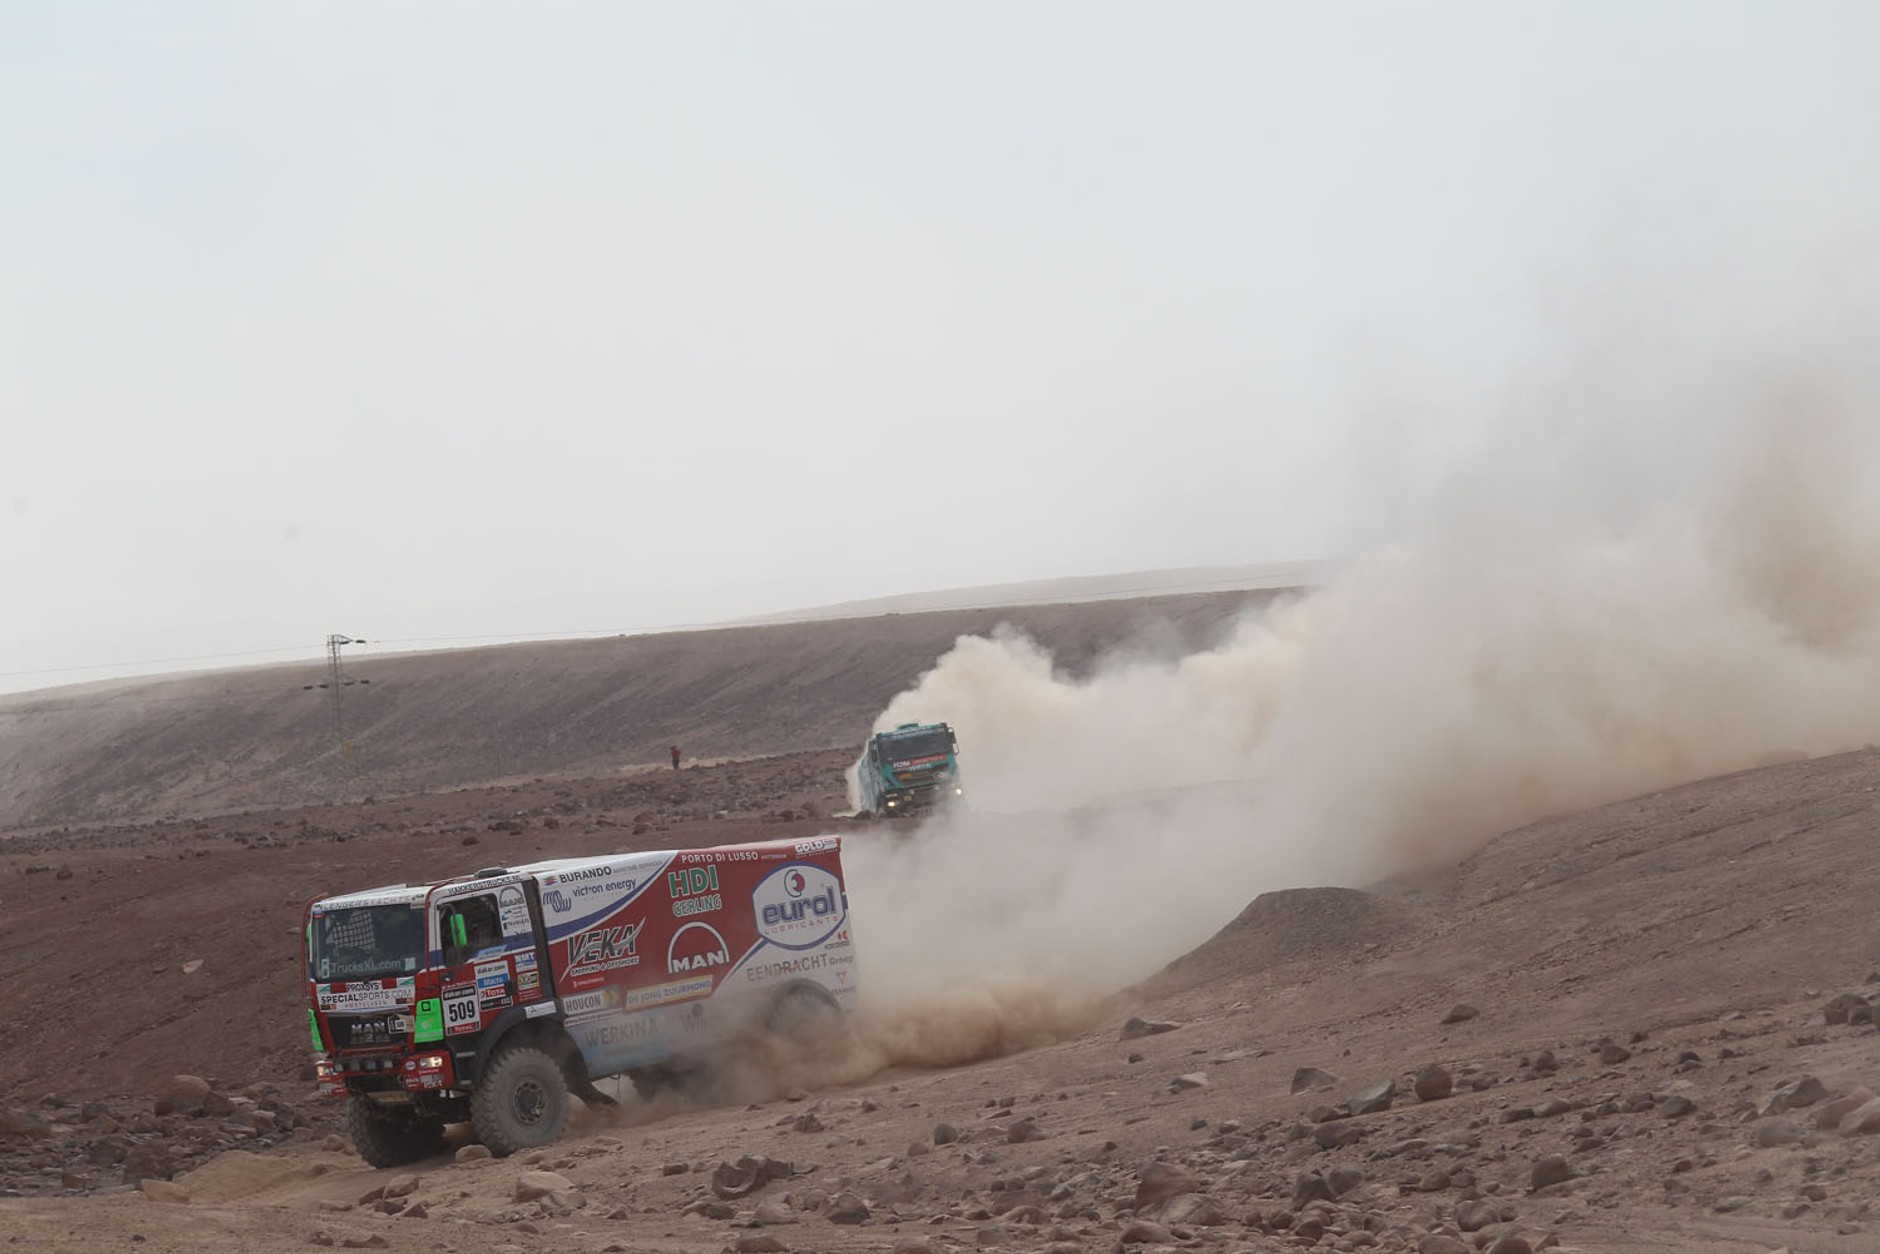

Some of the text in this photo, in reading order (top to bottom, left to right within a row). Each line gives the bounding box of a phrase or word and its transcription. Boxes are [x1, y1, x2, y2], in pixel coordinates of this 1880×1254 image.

[795, 840, 824, 853] GOLD
[681, 853, 713, 863] PORTO
[715, 852, 726, 862] DI
[728, 851, 759, 862] LUSSO
[559, 866, 612, 884] BURANDO
[668, 865, 720, 898] HDI
[605, 879, 637, 893] energy
[672, 894, 723, 917] GERLING
[762, 885, 838, 927] eurol
[764, 916, 839, 935] LUBRICANTS
[568, 924, 637, 967] VEKA
[329, 959, 401, 973] TrucksXL.com
[477, 964, 506, 975] dakar.com
[672, 950, 726, 973] MAN
[746, 954, 828, 982] EENDRACHT
[347, 982, 380, 992] PROXSYS
[483, 977, 503, 986] Macro
[443, 987, 475, 998] dakar.com
[448, 1000, 476, 1022] 509
[565, 992, 601, 1013] HOUCON
[351, 1021, 385, 1035] MAN
[454, 1024, 475, 1032] TOTAL
[585, 1018, 660, 1047] WERKINA
